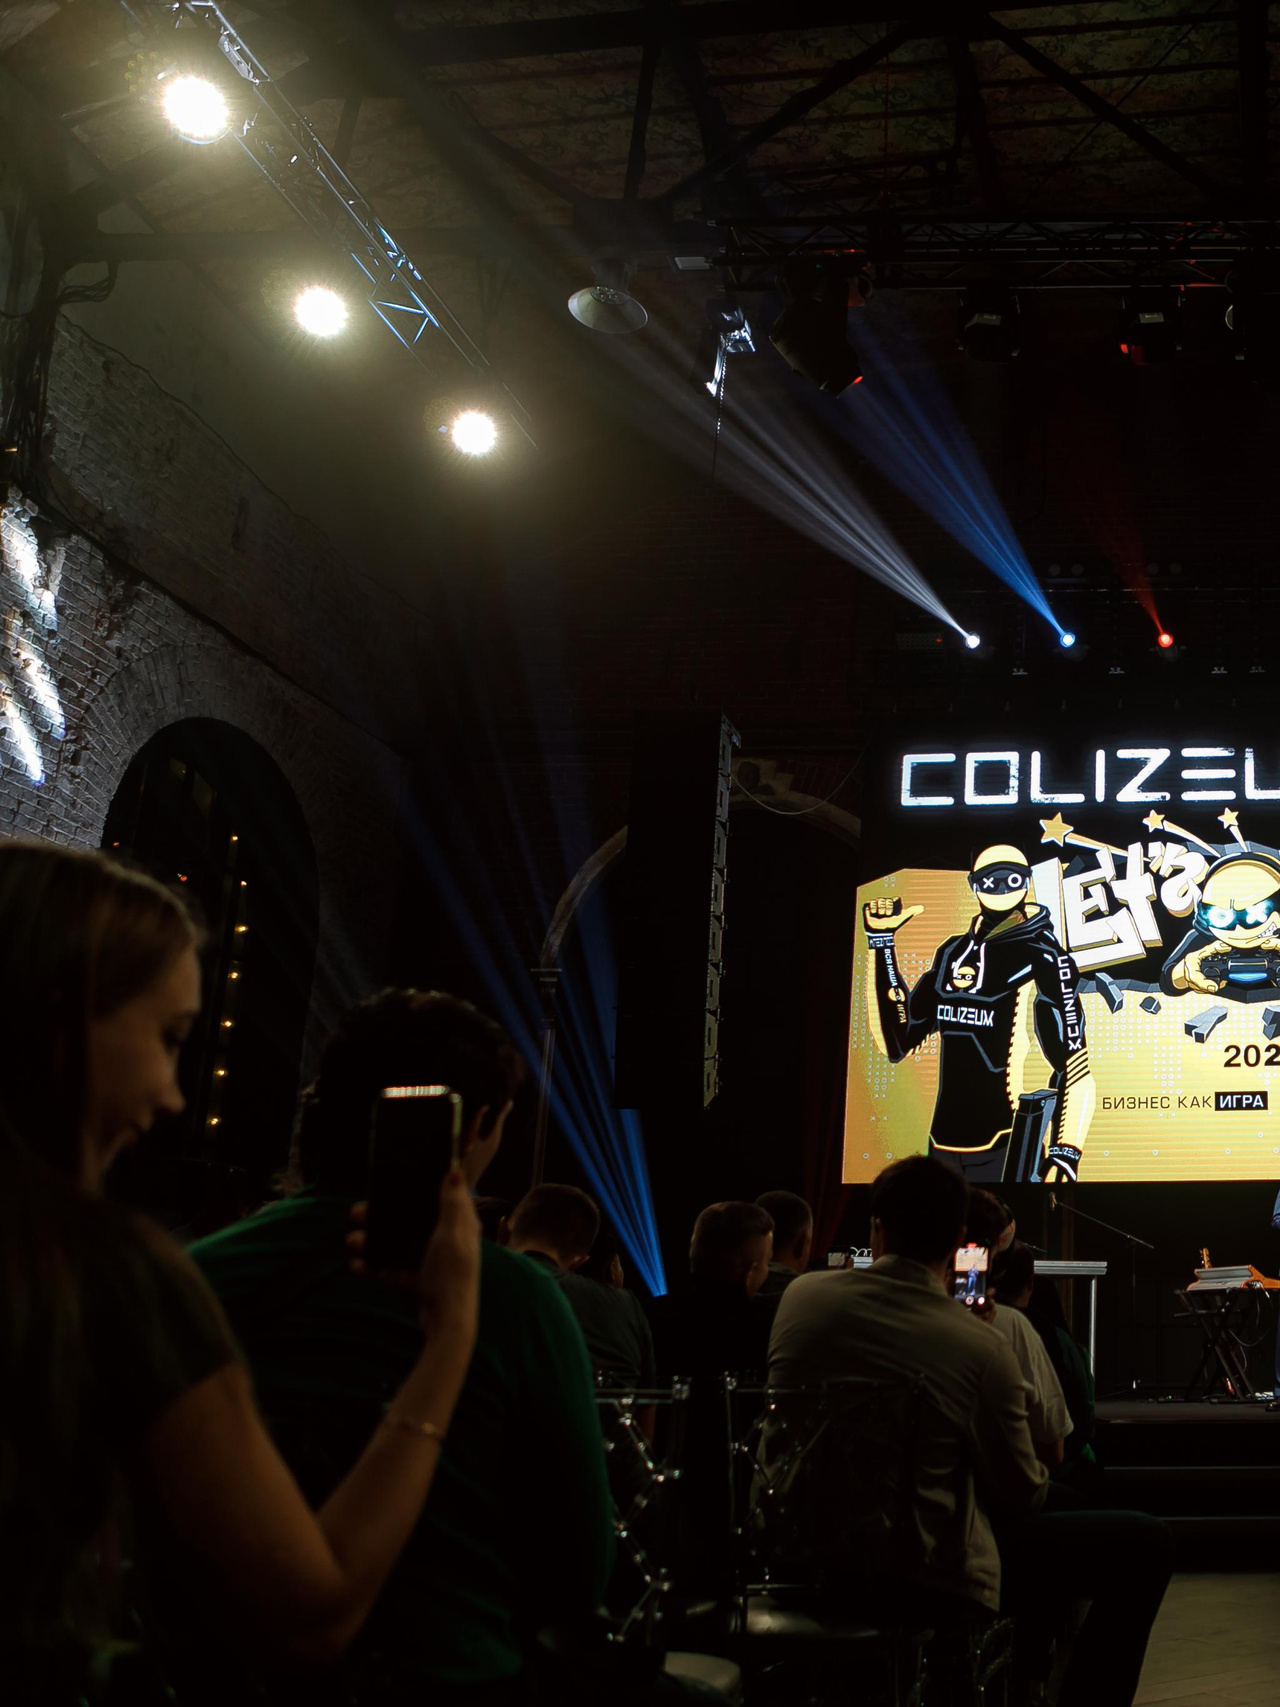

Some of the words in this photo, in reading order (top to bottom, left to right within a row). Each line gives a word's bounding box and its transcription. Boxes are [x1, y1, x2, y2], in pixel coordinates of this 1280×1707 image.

[887, 965, 898, 987] НАША
[937, 1005, 994, 1027] COLIZEUM
[1102, 1096, 1171, 1110] БИЗНЕС
[1178, 1095, 1212, 1109] КАК
[1219, 1093, 1264, 1109] ИГРА
